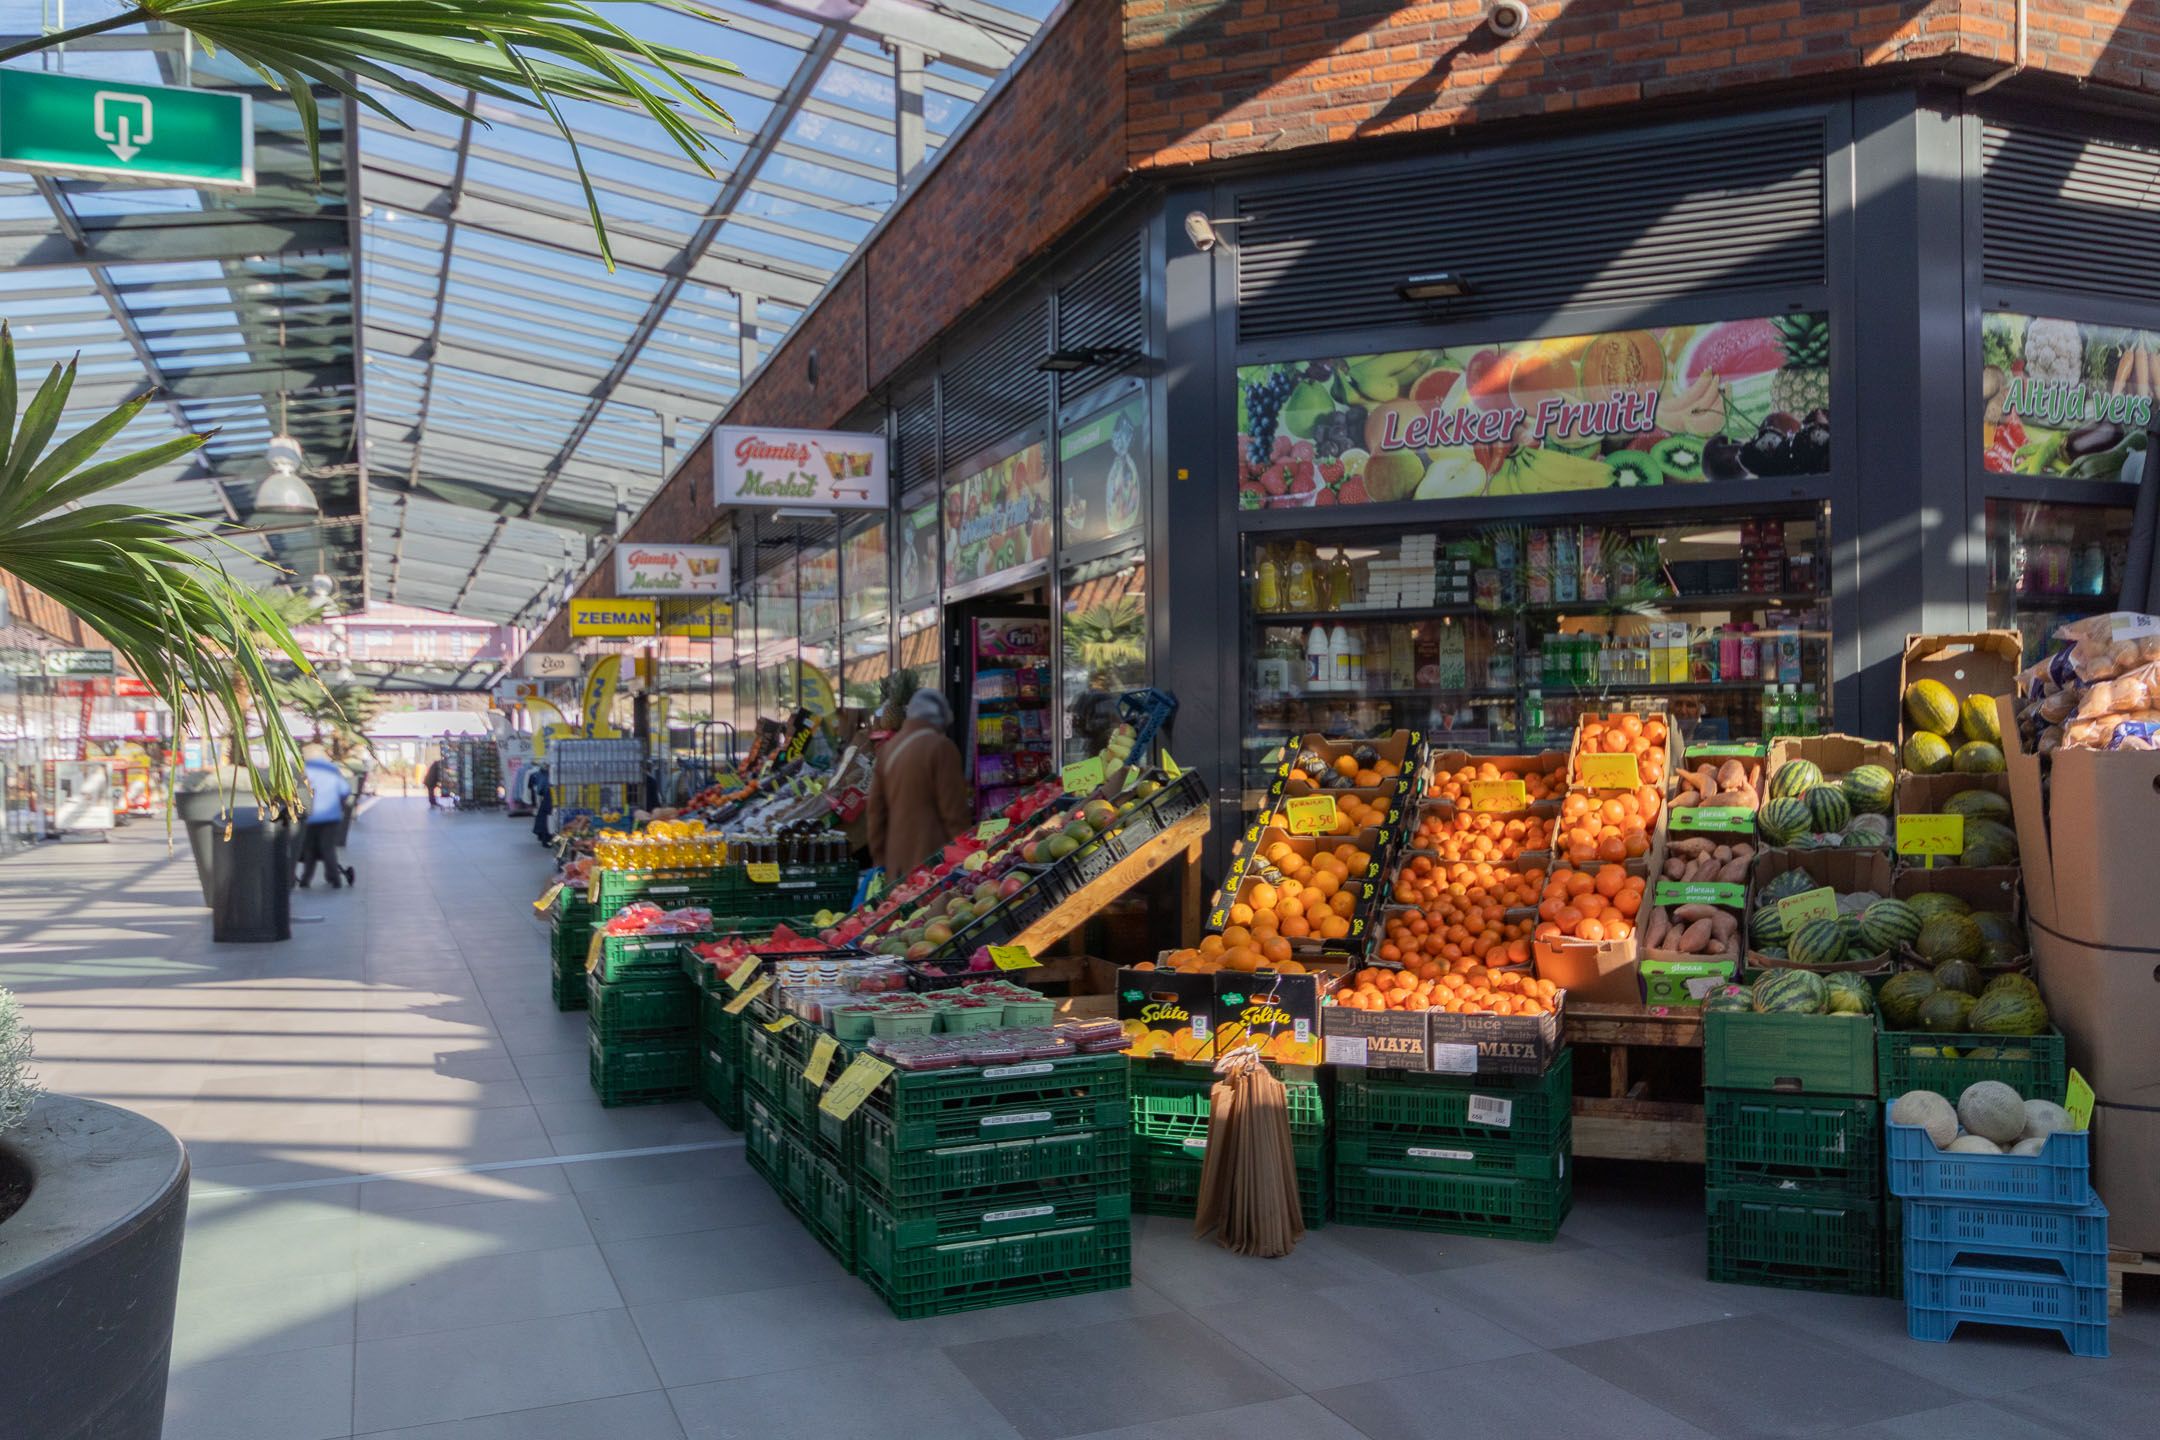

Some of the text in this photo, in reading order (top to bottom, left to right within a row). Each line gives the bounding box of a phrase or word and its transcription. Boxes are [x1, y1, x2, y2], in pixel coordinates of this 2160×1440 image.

[2002, 376, 2153, 426] Altijd vers
[1382, 390, 1659, 450] Lekker Fruit!
[735, 435, 811, 467] Gümüş
[736, 469, 818, 498] Market
[629, 571, 683, 589] Market
[577, 612, 651, 625] ZEEMAN
[1010, 629, 1035, 645] Fini
[540, 655, 566, 673] Etos
[1140, 1003, 1189, 1024] Solita
[1240, 1006, 1291, 1027] Solita
[1351, 1010, 1390, 1026] juice
[1391, 1024, 1425, 1037] healthy
[1461, 1016, 1502, 1032] juice
[1367, 1036, 1424, 1054] MAFA
[1478, 1041, 1537, 1059] MAFA
